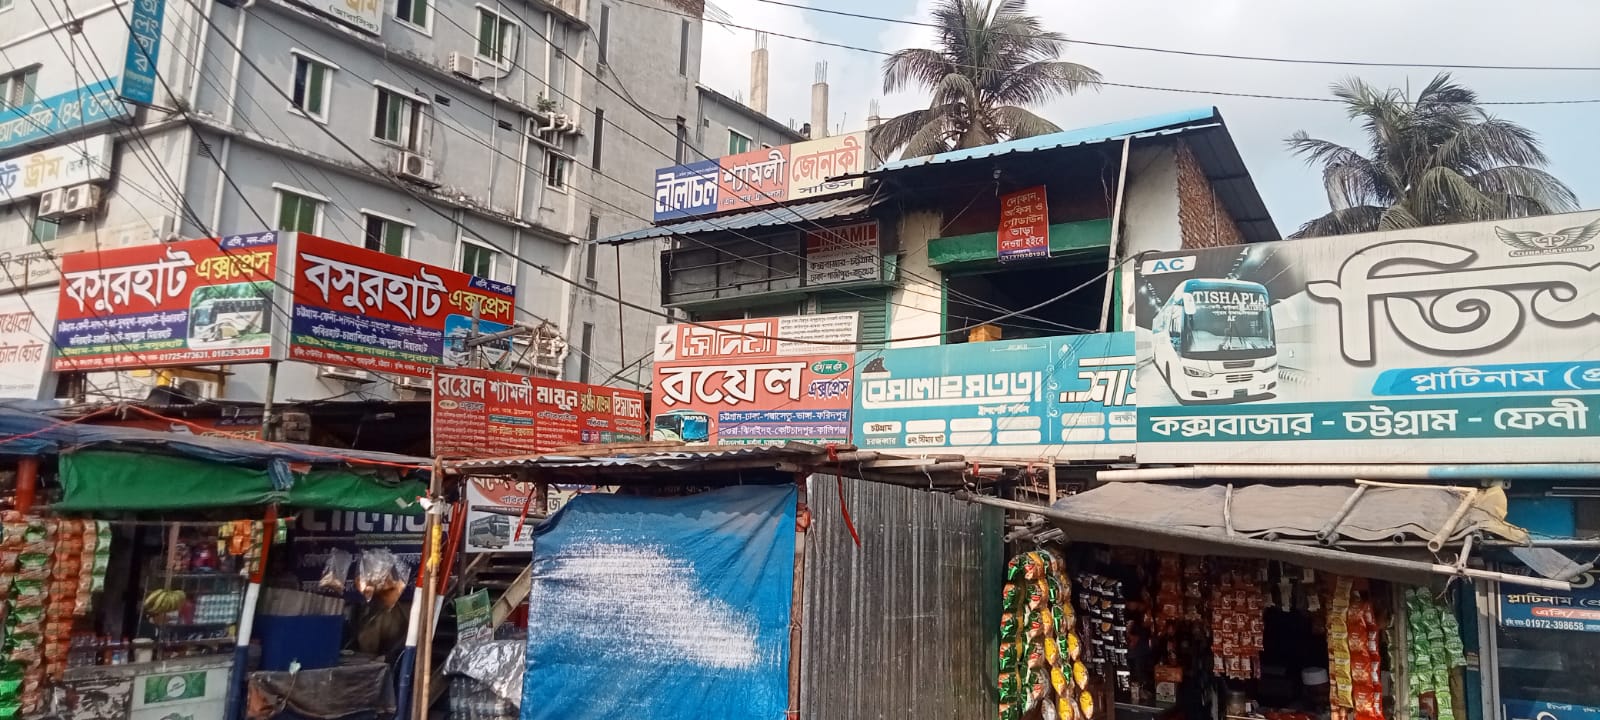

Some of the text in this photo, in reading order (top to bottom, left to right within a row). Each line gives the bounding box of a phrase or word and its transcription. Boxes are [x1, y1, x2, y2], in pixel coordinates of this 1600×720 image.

[721, 148, 786, 194] শ্যামলী
[793, 136, 862, 182] জোনাকী
[1011, 226, 1033, 236] ভাড়া
[64, 247, 196, 314] বসুরহাট
[195, 251, 273, 281] এক্সপ্রেস
[1152, 258, 1186, 274] AC
[300, 253, 448, 321] বসুরহাট
[449, 290, 511, 320] এক্সপ্রেস
[438, 373, 486, 399] রয়েল
[488, 377, 533, 406] শ্যামলী
[660, 361, 808, 407] রয়েল
[808, 378, 851, 400] এক্সপ্রেস
[1411, 366, 1548, 392] প্লাটিনাম
[536, 386, 578, 411] মামুন
[1149, 412, 1314, 438] কক্সবাজার
[1342, 405, 1459, 437] চট্টগ্রাম
[1494, 398, 1590, 430] ফেনী
[1507, 592, 1573, 606] প্লাটিনাম
